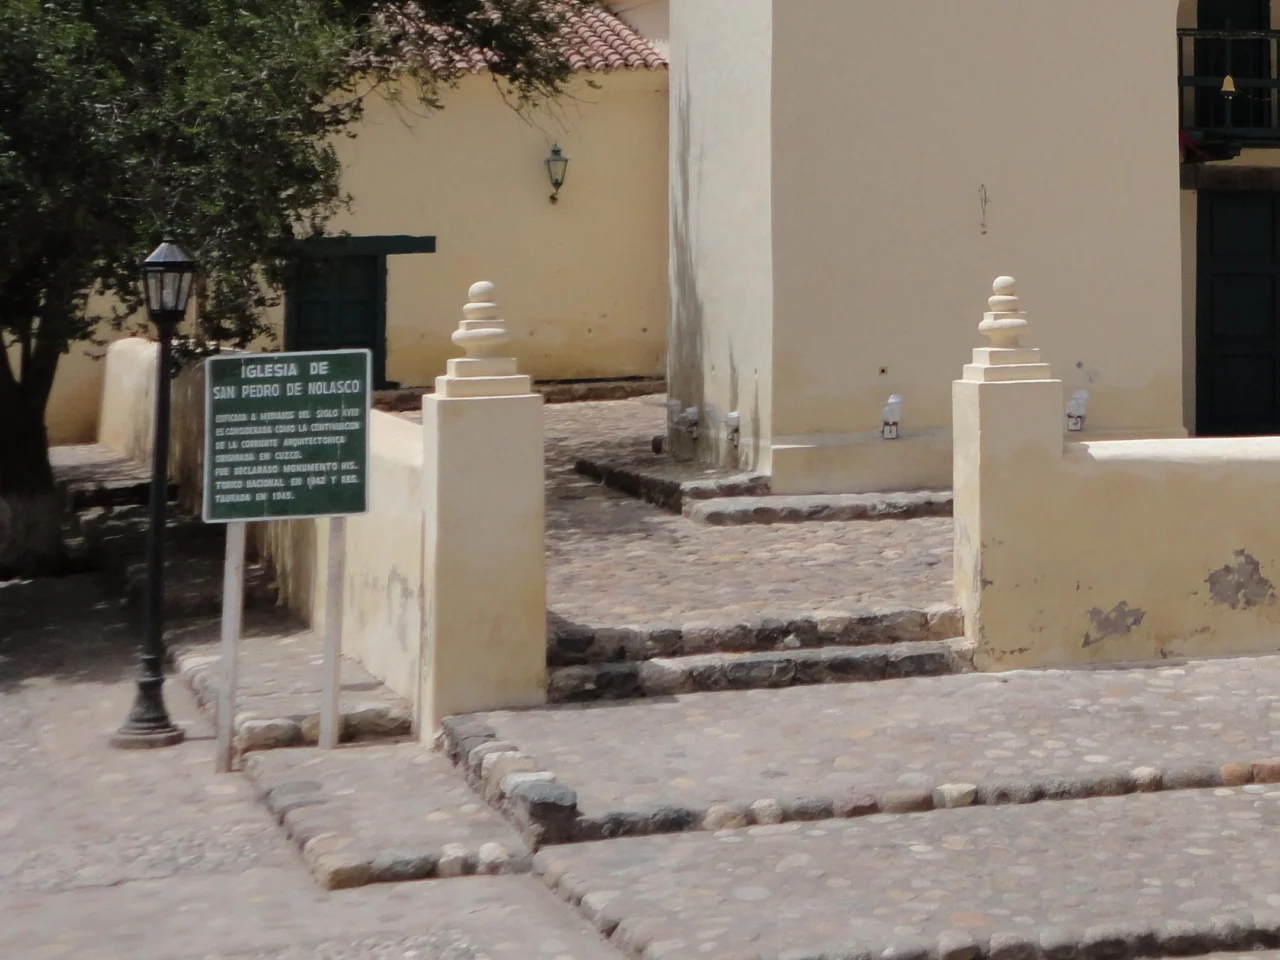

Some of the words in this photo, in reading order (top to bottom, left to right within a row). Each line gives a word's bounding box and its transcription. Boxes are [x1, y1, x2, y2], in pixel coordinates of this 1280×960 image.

[241, 364, 298, 378] IGLESIA
[310, 362, 329, 375] DE
[213, 386, 235, 399] SAN
[242, 384, 279, 398] PEDRO
[286, 383, 302, 396] DE
[308, 380, 359, 394] NOLASCO
[216, 414, 247, 422] EDIFICADA
[251, 413, 256, 421] A
[260, 412, 294, 421] MEDIADOS
[342, 408, 359, 416] XVIII
[216, 428, 224, 436] ES
[226, 426, 272, 435] CONSIDERADA
[311, 422, 360, 431] CONTINUACION
[228, 441, 237, 449] LA
[241, 439, 277, 448] CORRIENTE
[284, 436, 345, 446] ARQUITECTONICA
[216, 454, 254, 463] ORIGINADA
[275, 451, 302, 460] CUZCO.
[215, 468, 229, 476] FUE
[234, 466, 277, 475] DECLARADO
[283, 463, 337, 472] MONUMENTO
[216, 481, 242, 489] TORICO
[246, 479, 284, 488] NACIONAL
[291, 478, 302, 486] EN
[307, 477, 326, 485] 1942
[331, 476, 336, 484] Y
[215, 494, 250, 503] TAURADA
